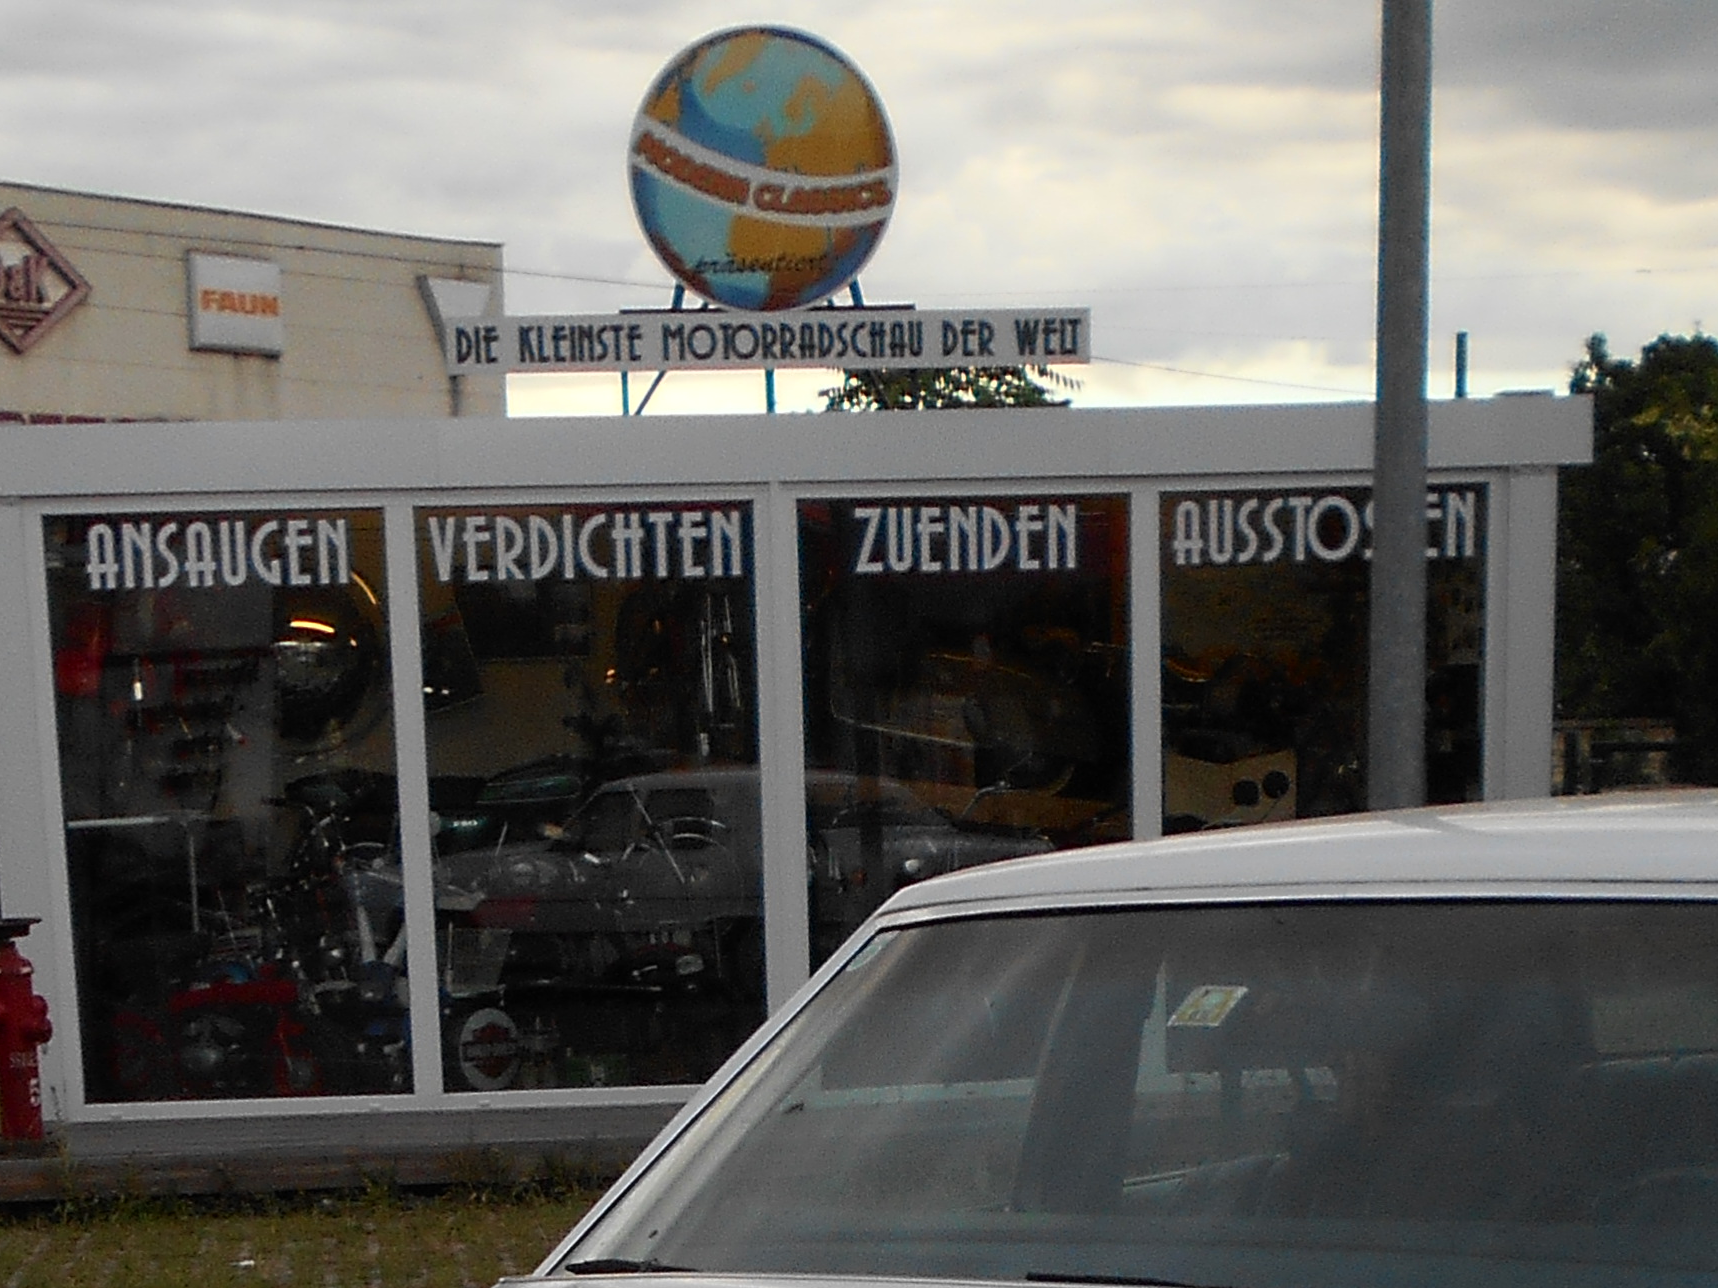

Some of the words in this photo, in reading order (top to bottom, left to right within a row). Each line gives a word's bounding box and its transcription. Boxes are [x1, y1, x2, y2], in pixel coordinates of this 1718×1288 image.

[200, 288, 279, 318] FAUN
[455, 325, 499, 365] DIE
[518, 323, 641, 363] KLEINSTE
[662, 320, 923, 361] MOTORRADSCHAU
[942, 320, 995, 357] DER
[1015, 317, 1082, 355] WELT
[87, 518, 349, 591] ANSAUGEN
[428, 508, 742, 581] VERDICHTEN
[854, 505, 1077, 574] ZUENDEN
[1173, 491, 1476, 566] AUSSTOEN
